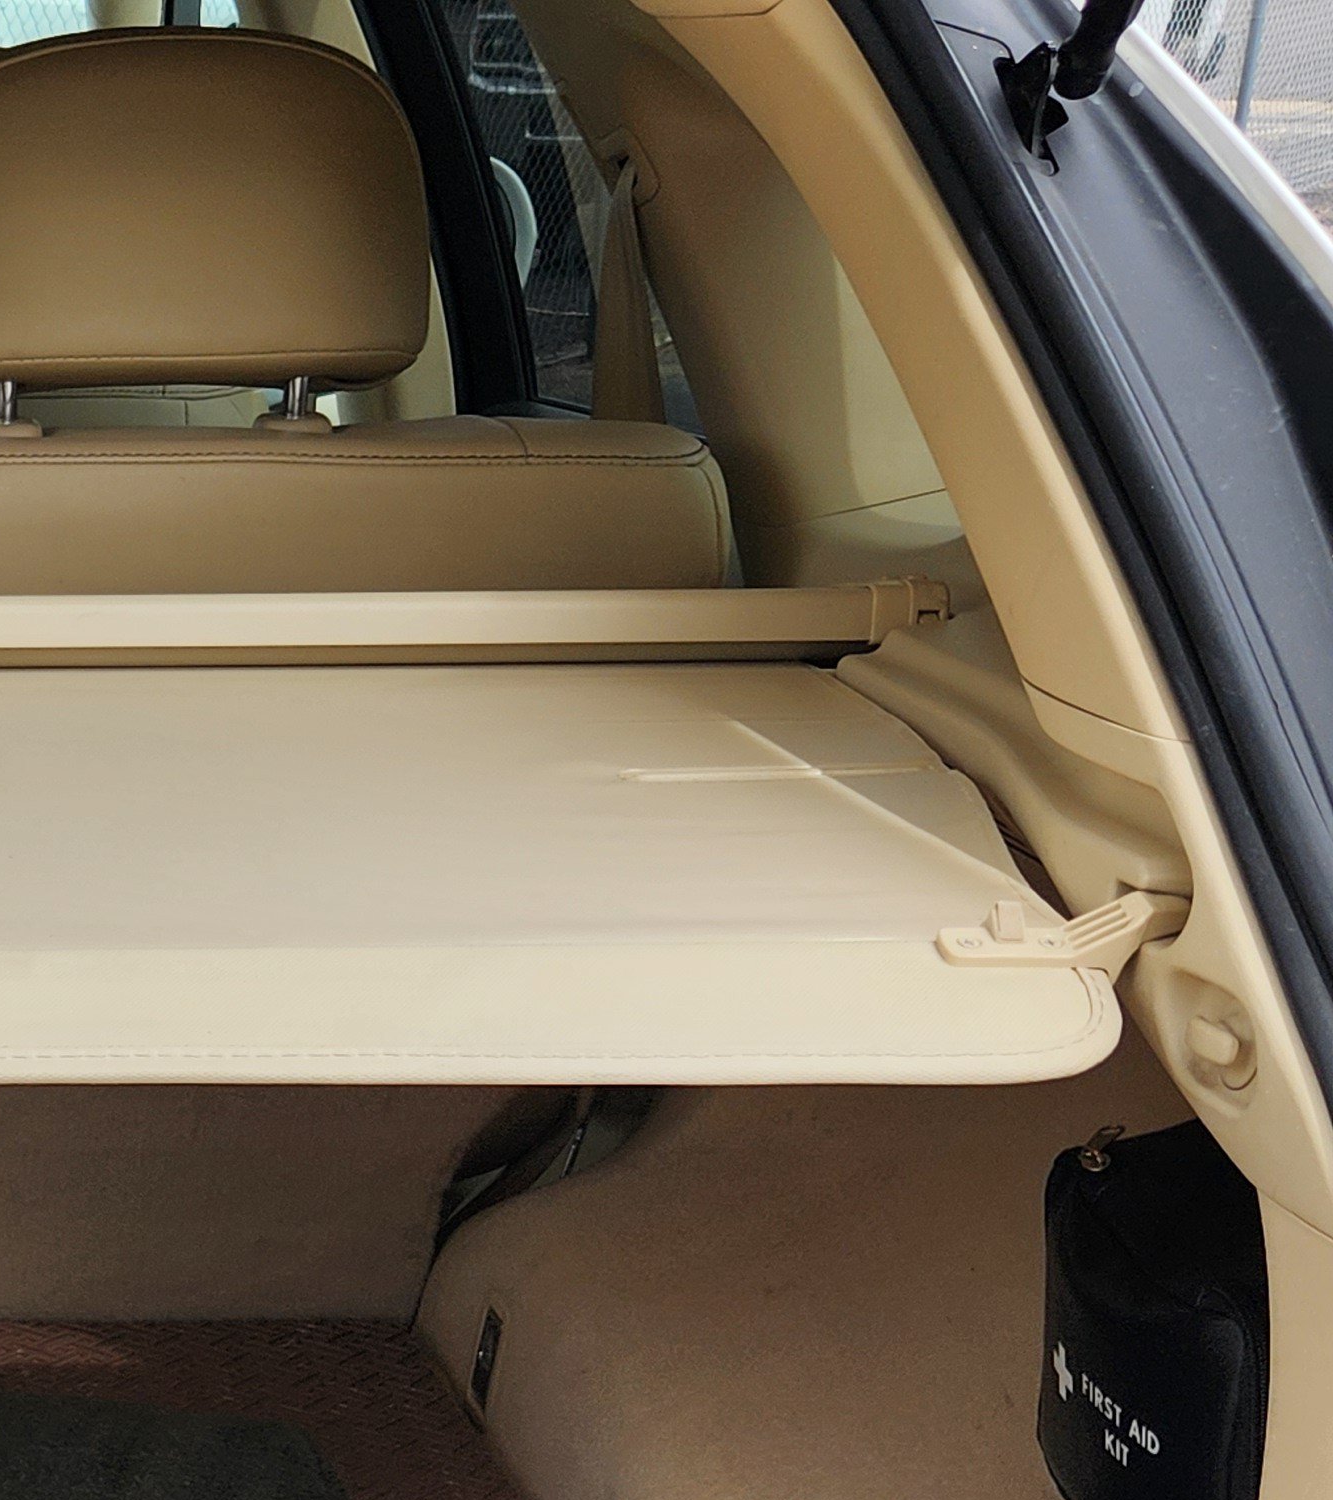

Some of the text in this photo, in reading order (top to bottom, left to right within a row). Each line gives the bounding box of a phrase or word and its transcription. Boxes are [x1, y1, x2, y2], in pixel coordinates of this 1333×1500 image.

[1081, 1372, 1160, 1455] FIRST AID
[1104, 1428, 1130, 1468] KIT
